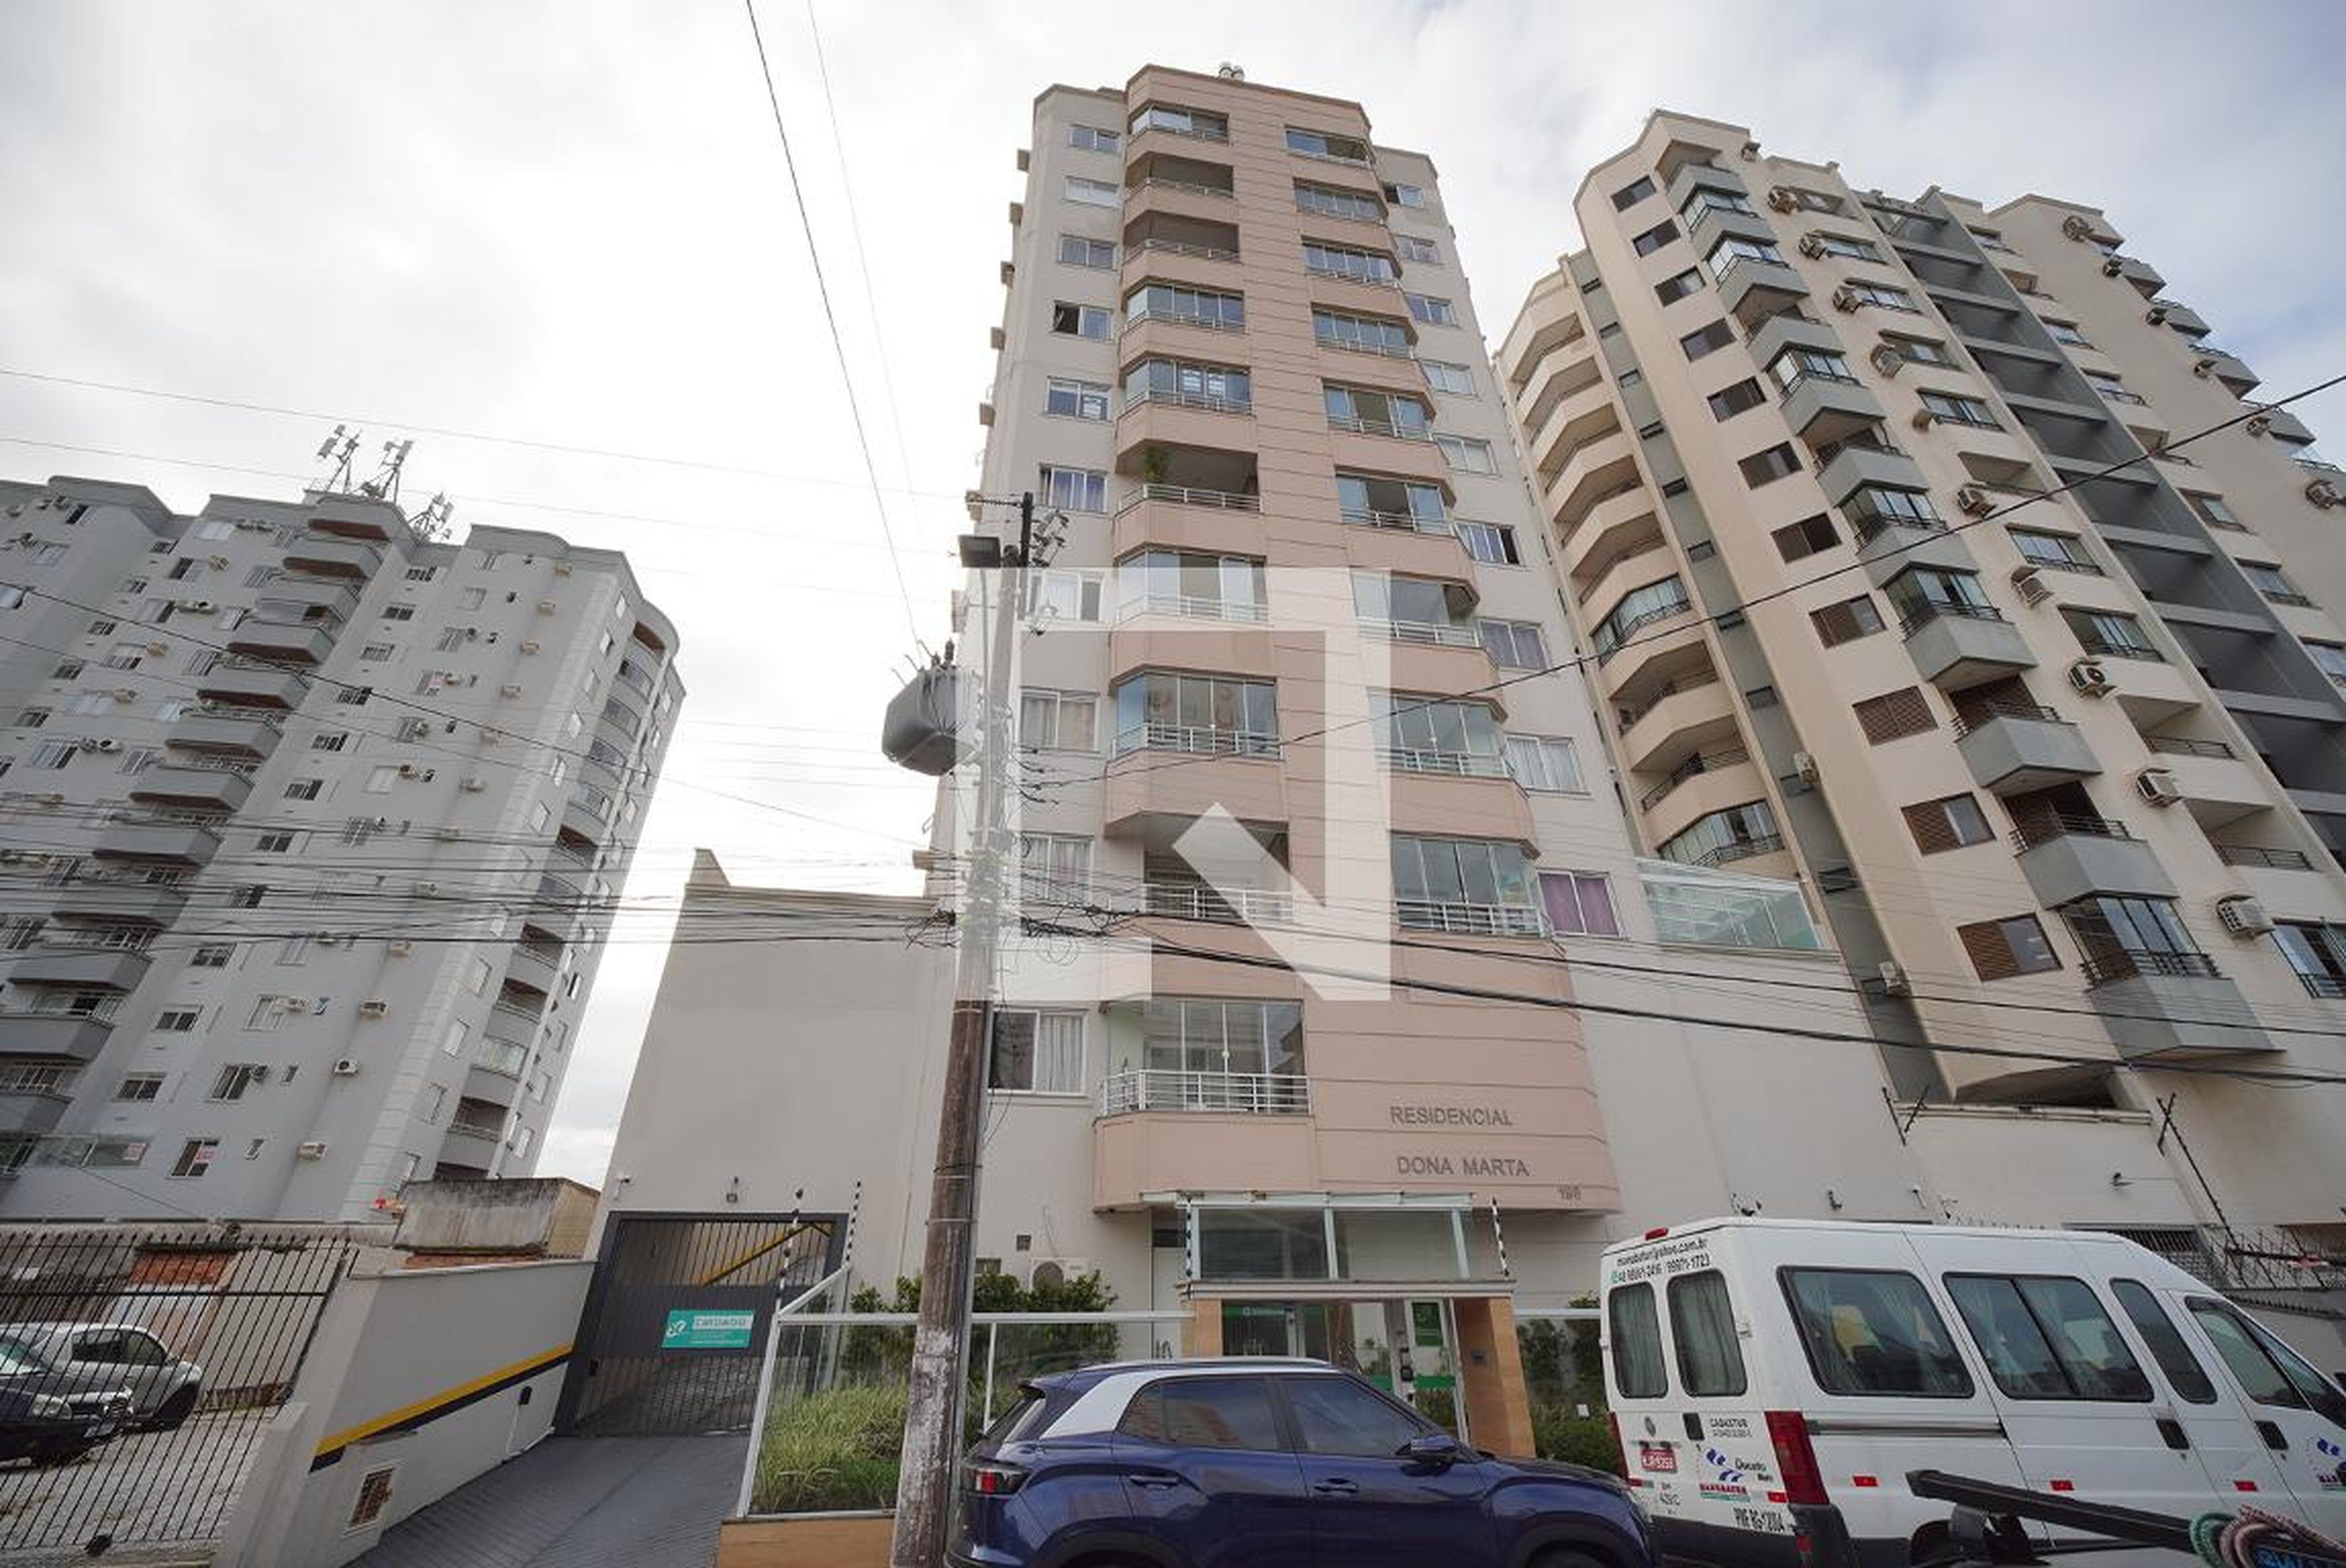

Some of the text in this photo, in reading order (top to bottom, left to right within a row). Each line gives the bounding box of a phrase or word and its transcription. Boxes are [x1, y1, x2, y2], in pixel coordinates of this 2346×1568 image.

[1390, 1106, 1513, 1126] RESIDENCIAL
[1397, 1156, 1530, 1176] DONA MARTA
